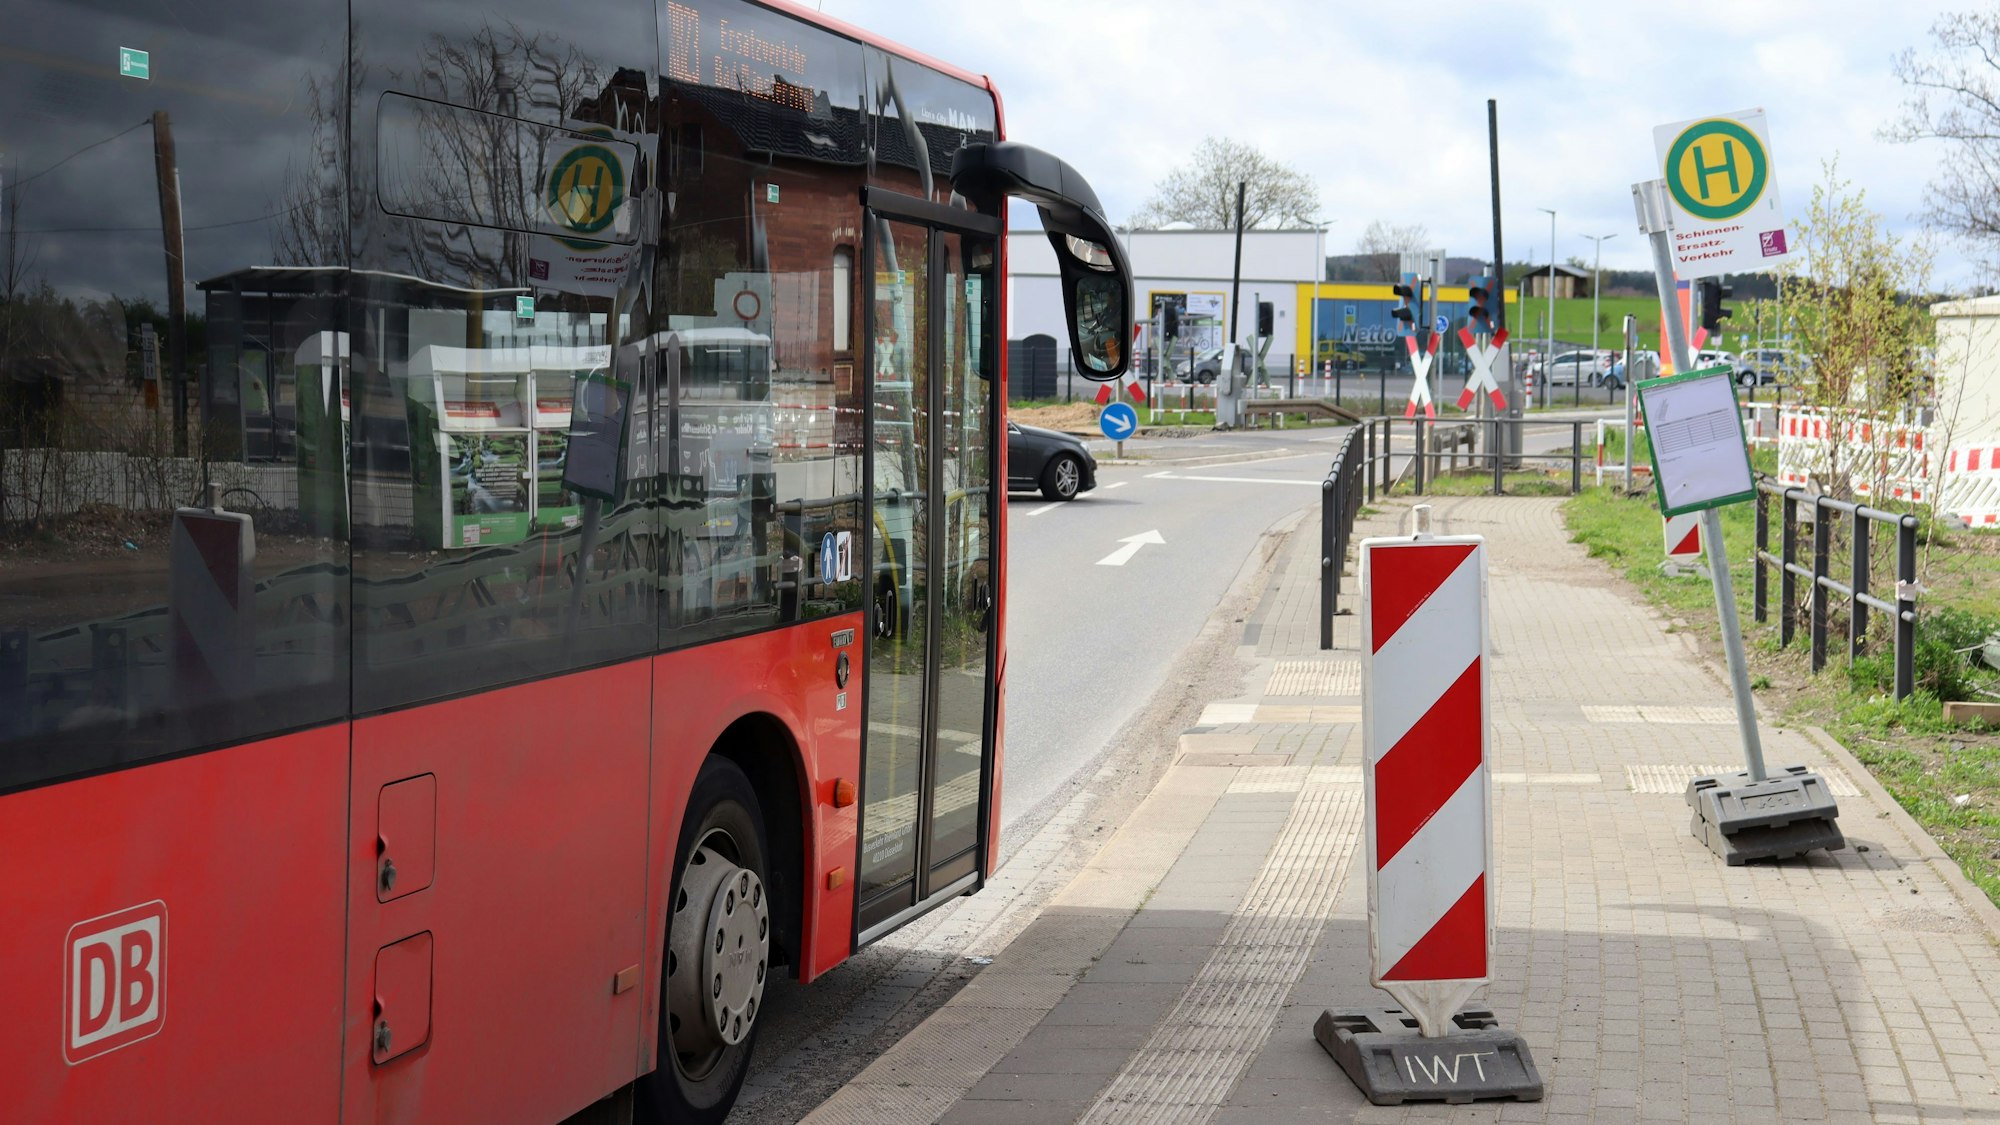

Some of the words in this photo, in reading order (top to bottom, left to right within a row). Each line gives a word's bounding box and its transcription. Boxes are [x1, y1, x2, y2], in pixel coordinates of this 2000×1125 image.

[720, 19, 807, 75] Ersatzverkehr
[948, 107, 977, 135] MAN
[1692, 140, 1740, 200] H
[1675, 224, 1744, 241] Schienen-
[1677, 240, 1726, 252] Ersatz-
[1679, 248, 1734, 263] Verkehr
[1343, 324, 1397, 345] Netto
[79, 929, 154, 1028] DB
[1404, 1051, 1494, 1085] IWT
